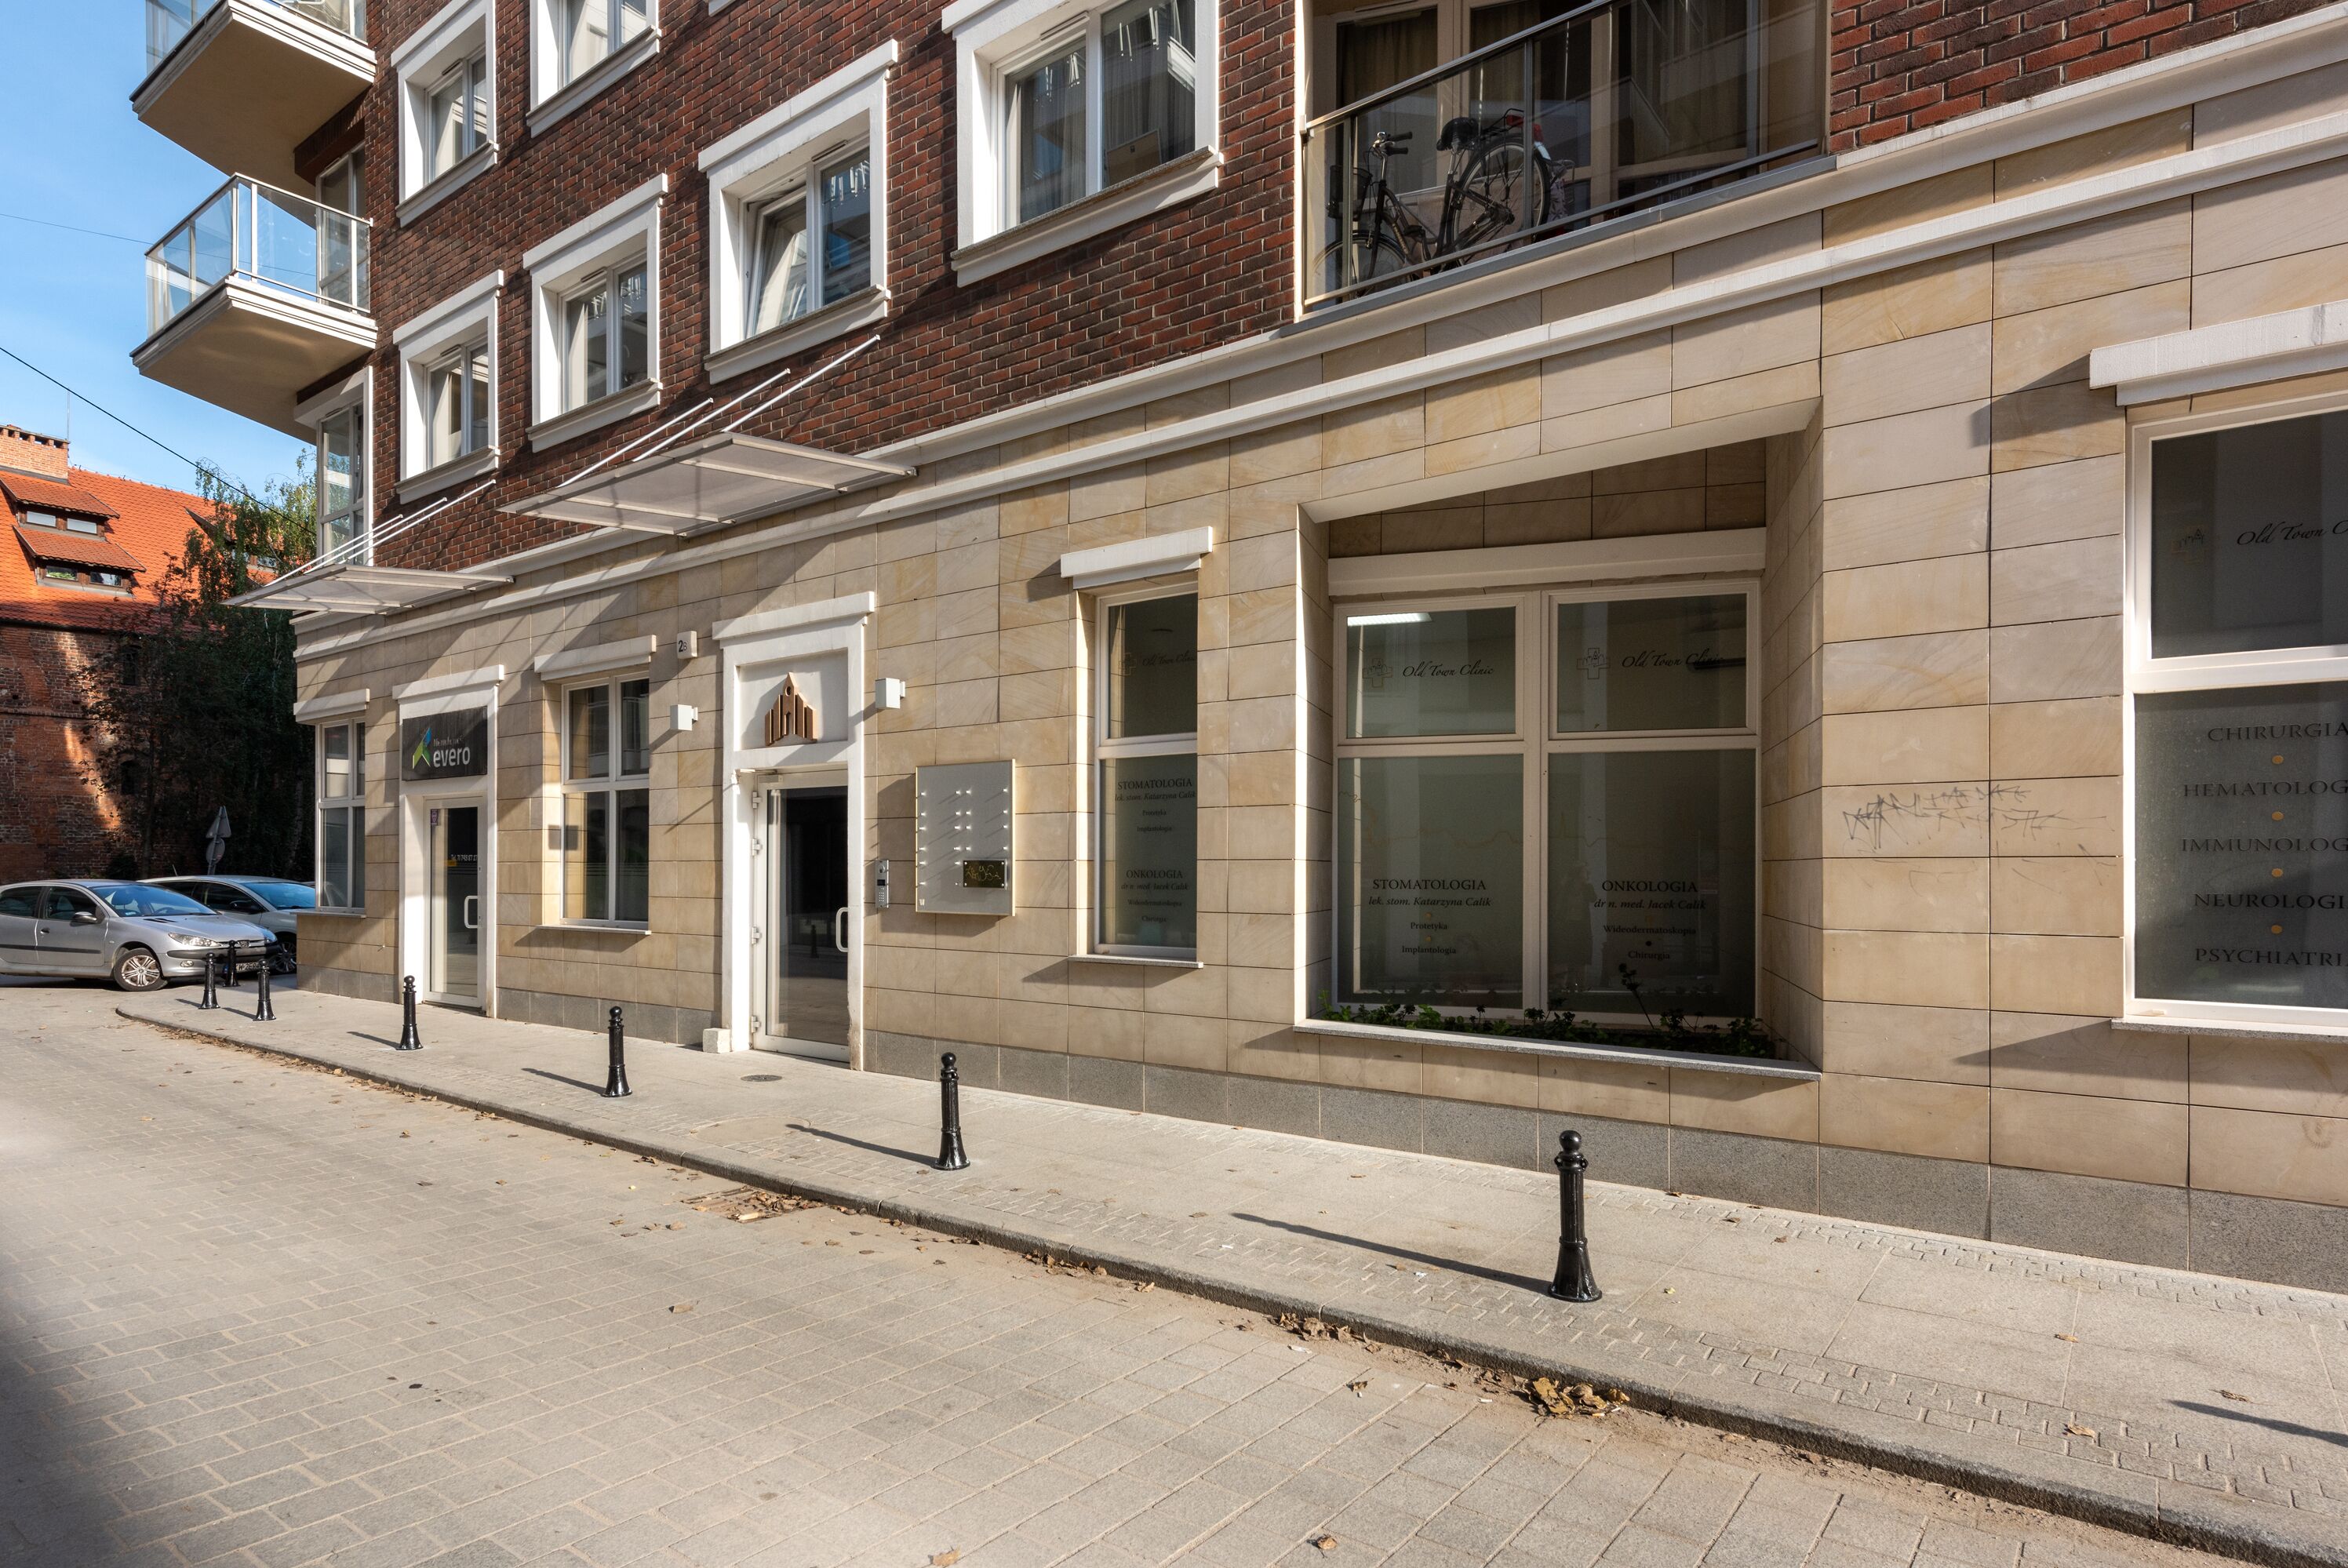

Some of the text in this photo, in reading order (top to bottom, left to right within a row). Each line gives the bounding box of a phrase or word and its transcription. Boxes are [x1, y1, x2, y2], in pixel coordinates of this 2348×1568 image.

[2237, 521, 2286, 545] Old
[2281, 522, 2327, 540] Town
[1621, 650, 1655, 668] Old
[1651, 653, 1683, 667] Town
[1403, 659, 1495, 677] Old Town Clinic
[2207, 722, 2348, 741] CHIRURGIA
[433, 746, 471, 768] evero
[1117, 778, 1192, 790] STOMATOLOGIA
[1126, 869, 1183, 879] ONKOLOGIA
[1372, 879, 1487, 891] STOMATOLOGIA
[1601, 880, 1698, 893] ONKOLOGIA
[1368, 896, 1385, 906] lek.
[1413, 897, 1462, 908] Katarzyna
[1465, 897, 1492, 907] Calik
[1594, 899, 1607, 908] dr
[1620, 900, 1645, 908] med.
[1647, 900, 1676, 910] Jacek
[1677, 900, 1707, 910] Calik
[2194, 893, 2348, 911] NEUROLOGI
[1410, 922, 1448, 931] Protetyka
[1603, 925, 1697, 937] Wideodermatoskopia
[1401, 945, 1457, 955] Implantologia
[1627, 950, 1670, 961] Chirurgia
[2195, 948, 2348, 967] PSYCHIATRI
